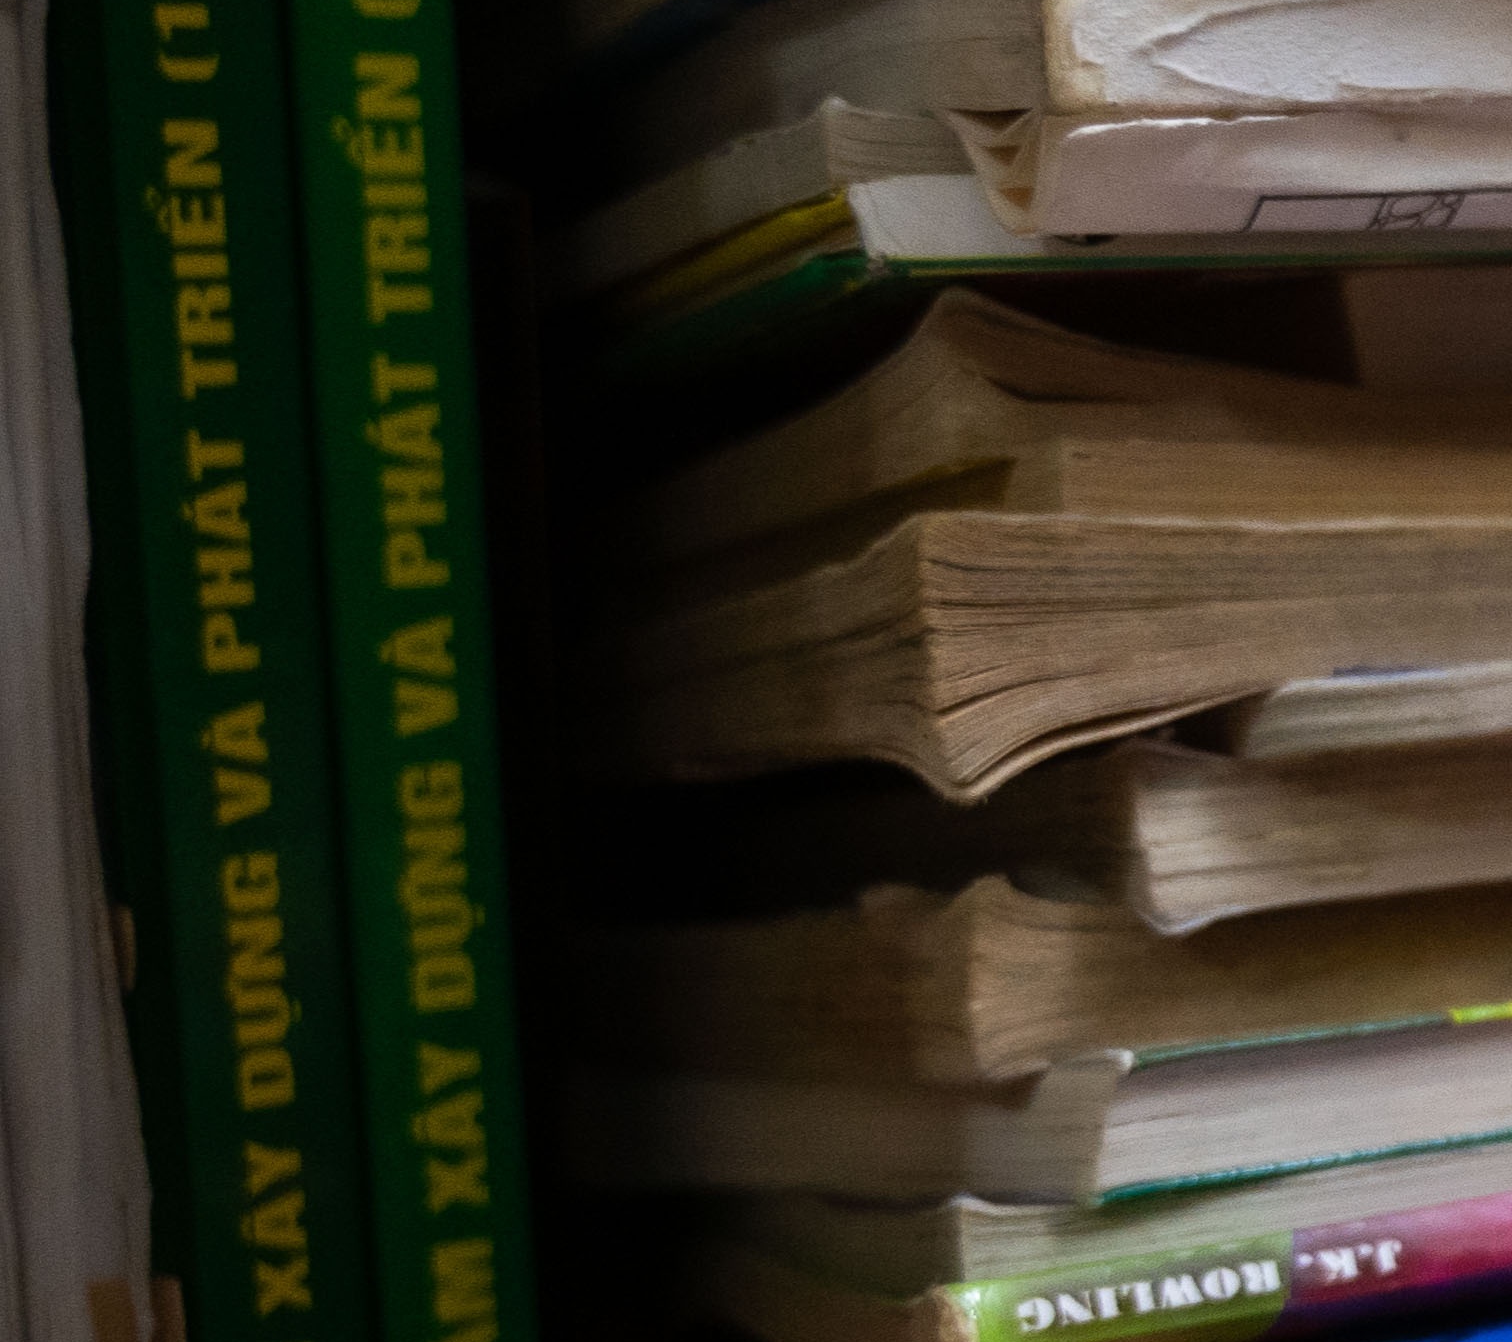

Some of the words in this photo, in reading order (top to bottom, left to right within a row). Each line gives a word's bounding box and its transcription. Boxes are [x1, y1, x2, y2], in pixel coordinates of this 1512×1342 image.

[142, 116, 238, 401] TRIỂN
[330, 51, 434, 327] TRIỂN
[181, 429, 260, 672] PHÁT
[363, 350, 454, 591] PHÁT
[195, 700, 272, 827] VÀ
[372, 613, 462, 739] VÀ
[219, 849, 303, 1112] DỰNG
[396, 759, 486, 1015] DỰNG
[238, 1139, 314, 1318] XÂY
[410, 1039, 492, 1216] XÂY
[1017, 1261, 1280, 1335] ROWLING
[1298, 1239, 1400, 1285] J.K.
